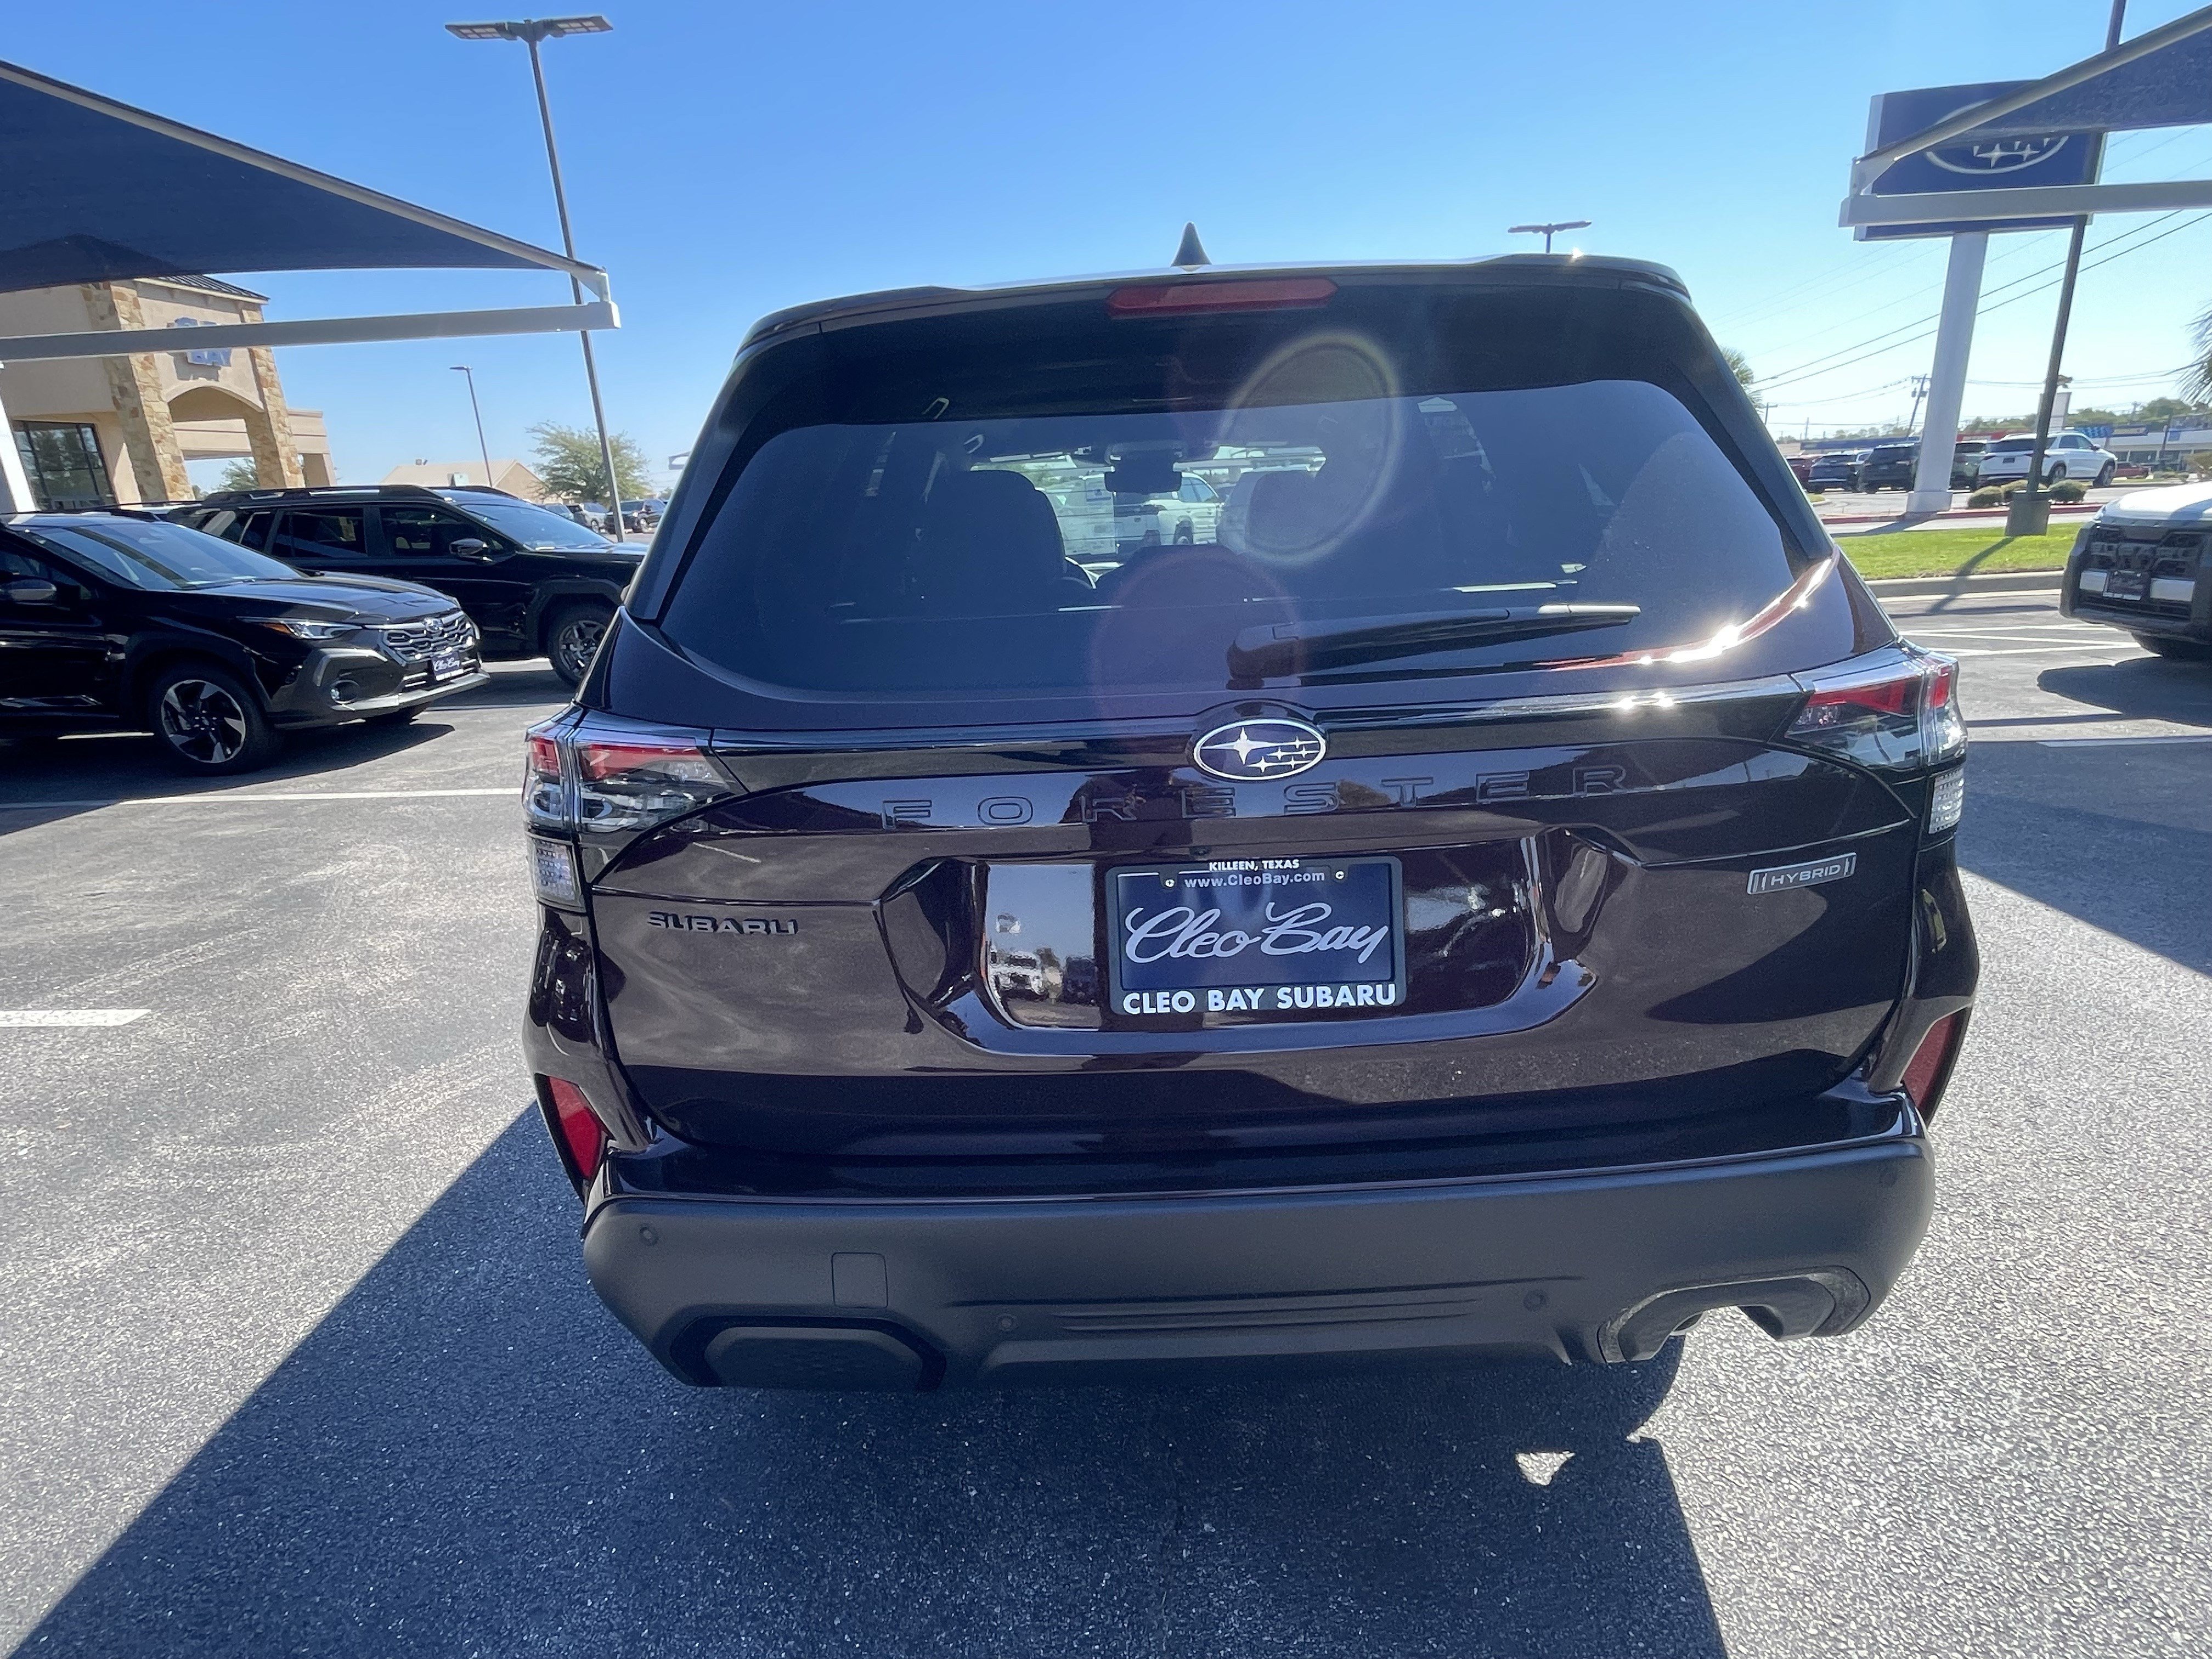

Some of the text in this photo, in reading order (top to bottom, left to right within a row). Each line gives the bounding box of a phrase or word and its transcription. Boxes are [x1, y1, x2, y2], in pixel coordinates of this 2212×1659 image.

[882, 765, 1627, 830] FORESTER
[1209, 859, 1300, 871] KILLEEN, TEXAS
[1771, 865, 1841, 885] HYBRID
[1184, 872, 1325, 888] www.CleoBay.com
[647, 911, 799, 935] SUBARU
[1125, 902, 1389, 964] Cleo Bay
[1123, 984, 1396, 1015] CLEO BAY SUBARU
